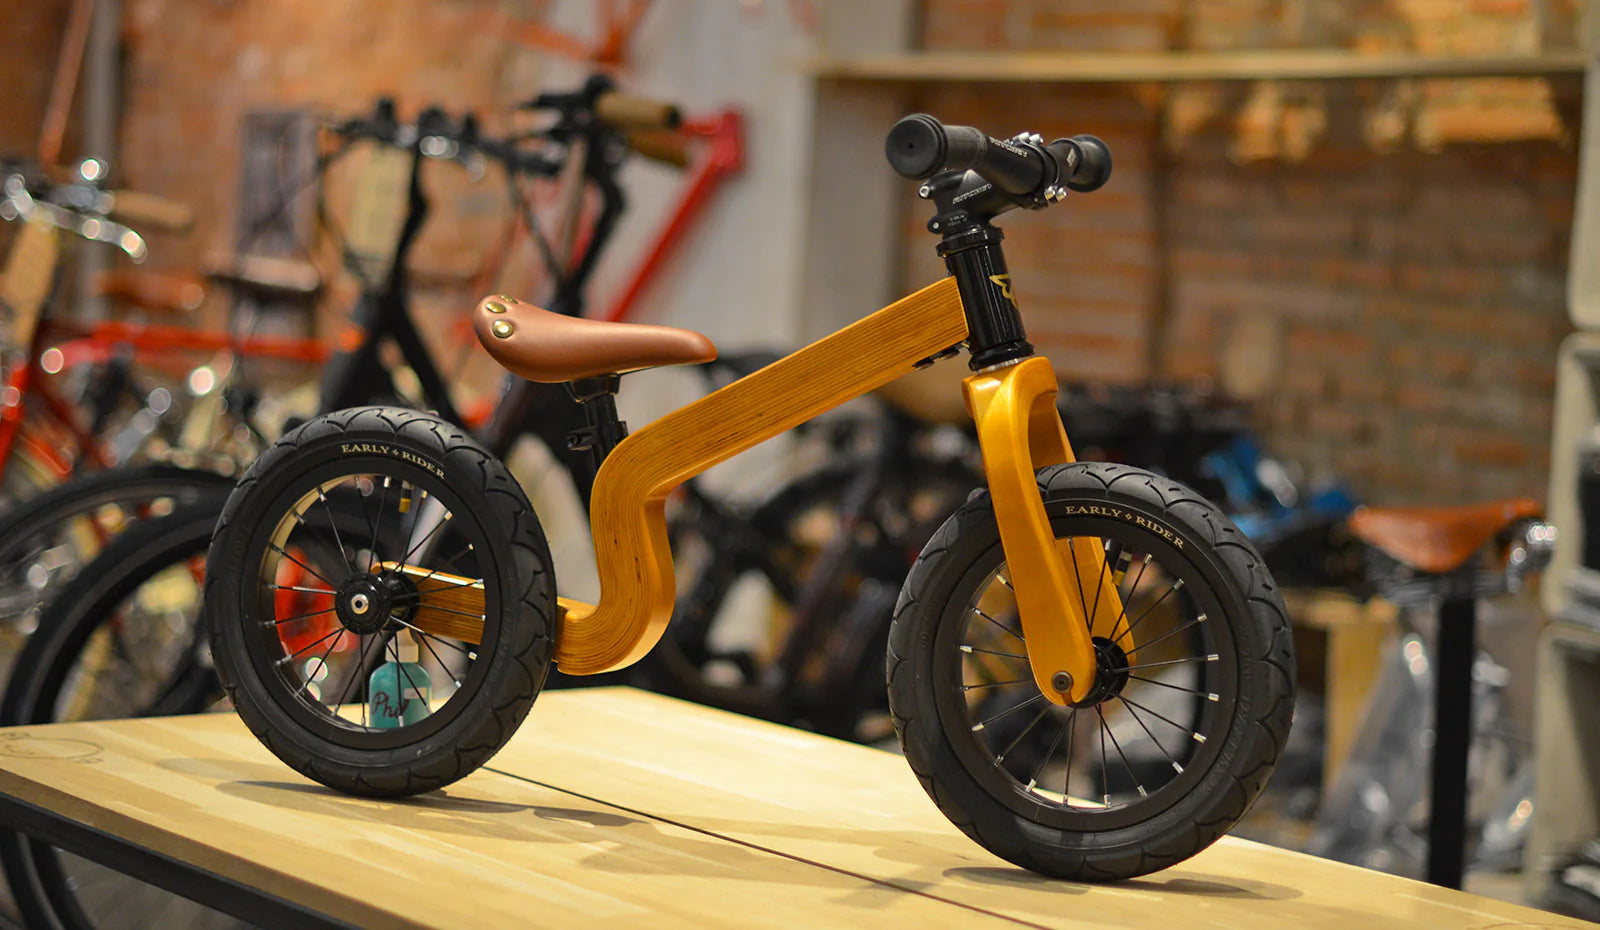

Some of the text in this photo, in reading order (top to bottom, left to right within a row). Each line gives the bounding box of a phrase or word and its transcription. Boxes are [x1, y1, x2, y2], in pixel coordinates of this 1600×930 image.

[341, 443, 445, 479] EARLY RIDER
[1065, 506, 1184, 549] EARLY RIDER
